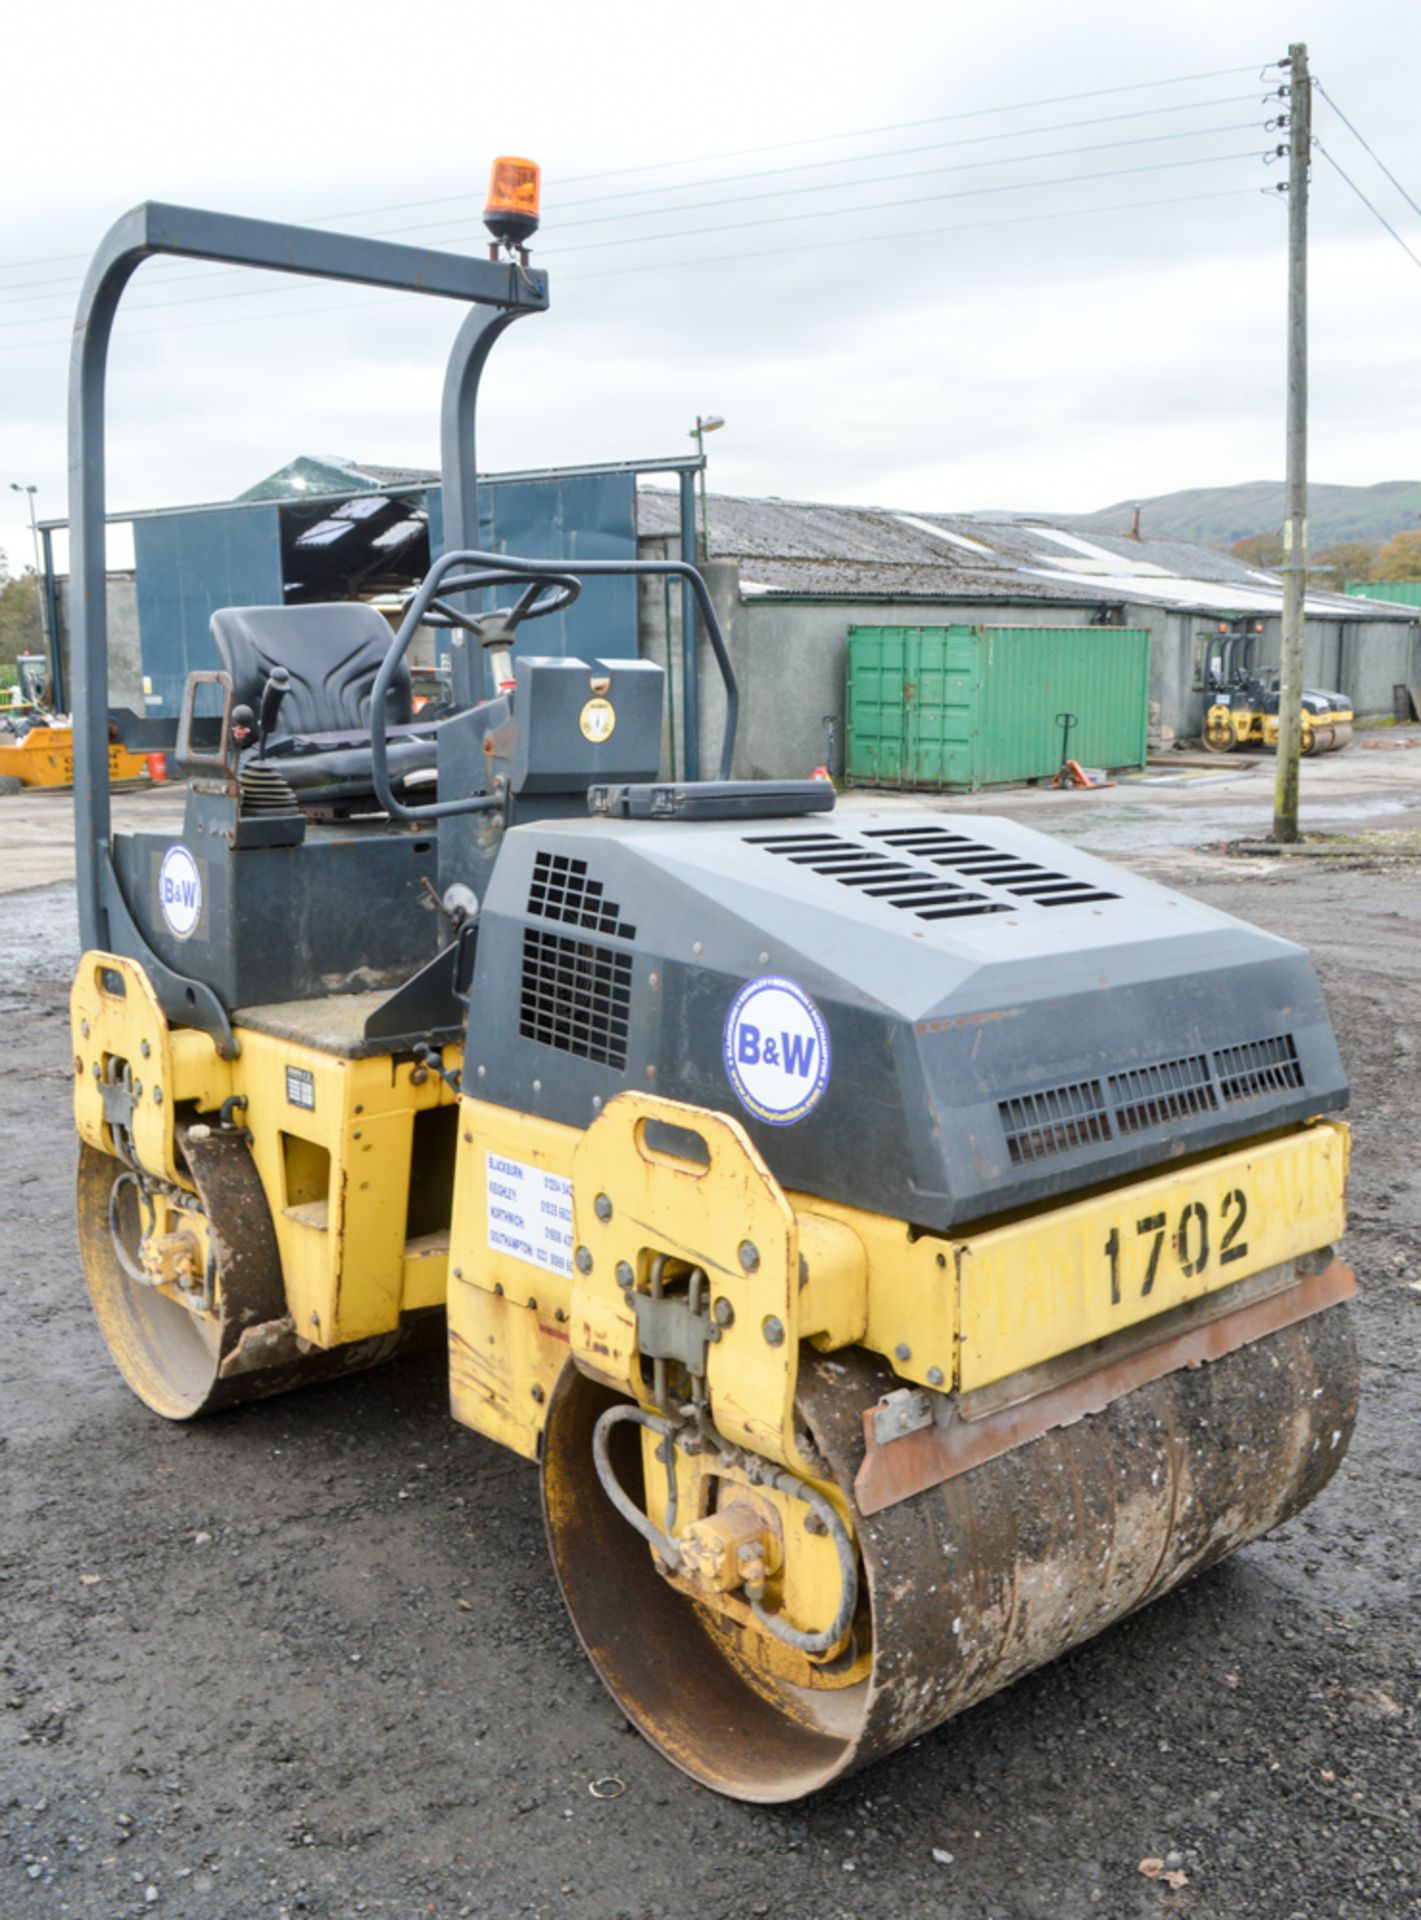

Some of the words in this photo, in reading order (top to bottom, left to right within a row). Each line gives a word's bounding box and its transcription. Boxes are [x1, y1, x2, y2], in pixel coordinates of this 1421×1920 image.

[165, 877, 196, 908] B&W
[738, 1023, 816, 1078] B&W
[1105, 1188, 1248, 1305] 1702
